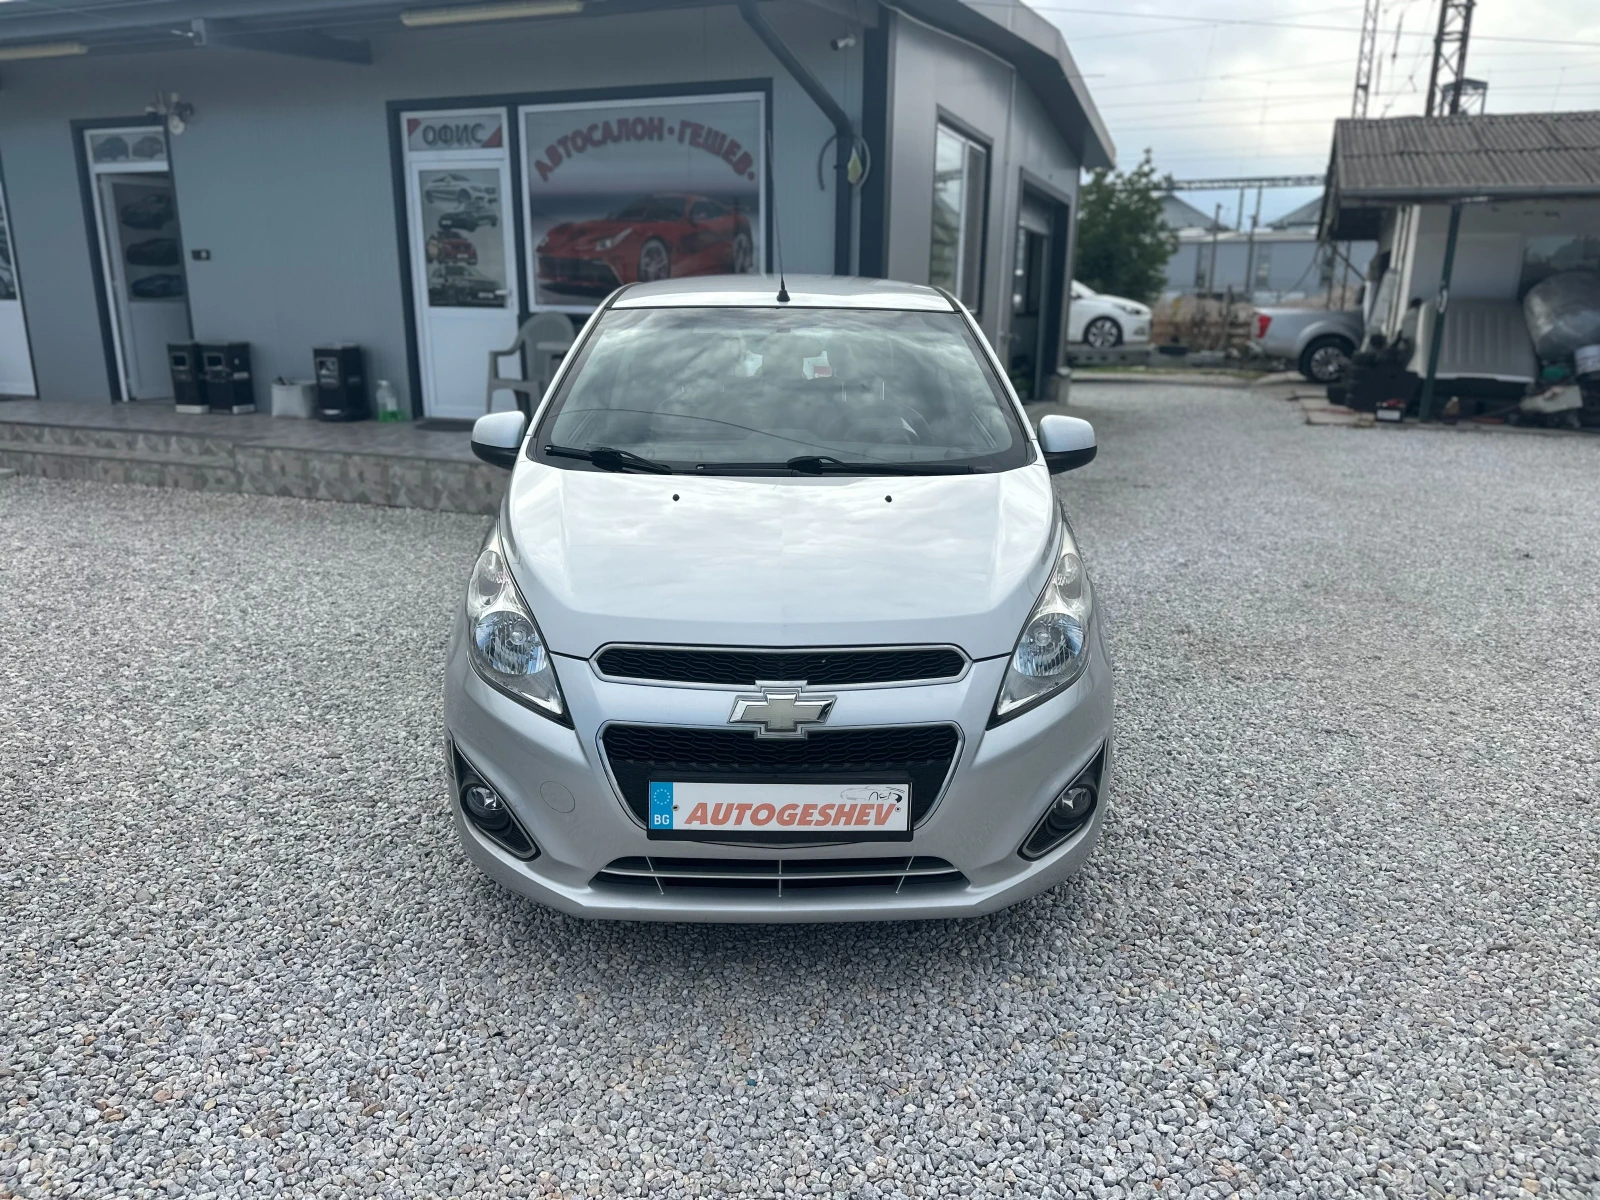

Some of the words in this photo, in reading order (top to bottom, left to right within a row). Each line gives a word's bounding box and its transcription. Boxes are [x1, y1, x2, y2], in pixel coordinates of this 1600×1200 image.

[422, 123, 486, 146] ОФИС
[534, 116, 664, 182] АВТОСАЛОН
[654, 814, 670, 825] BG
[684, 802, 897, 826] AUTOGESHEV
